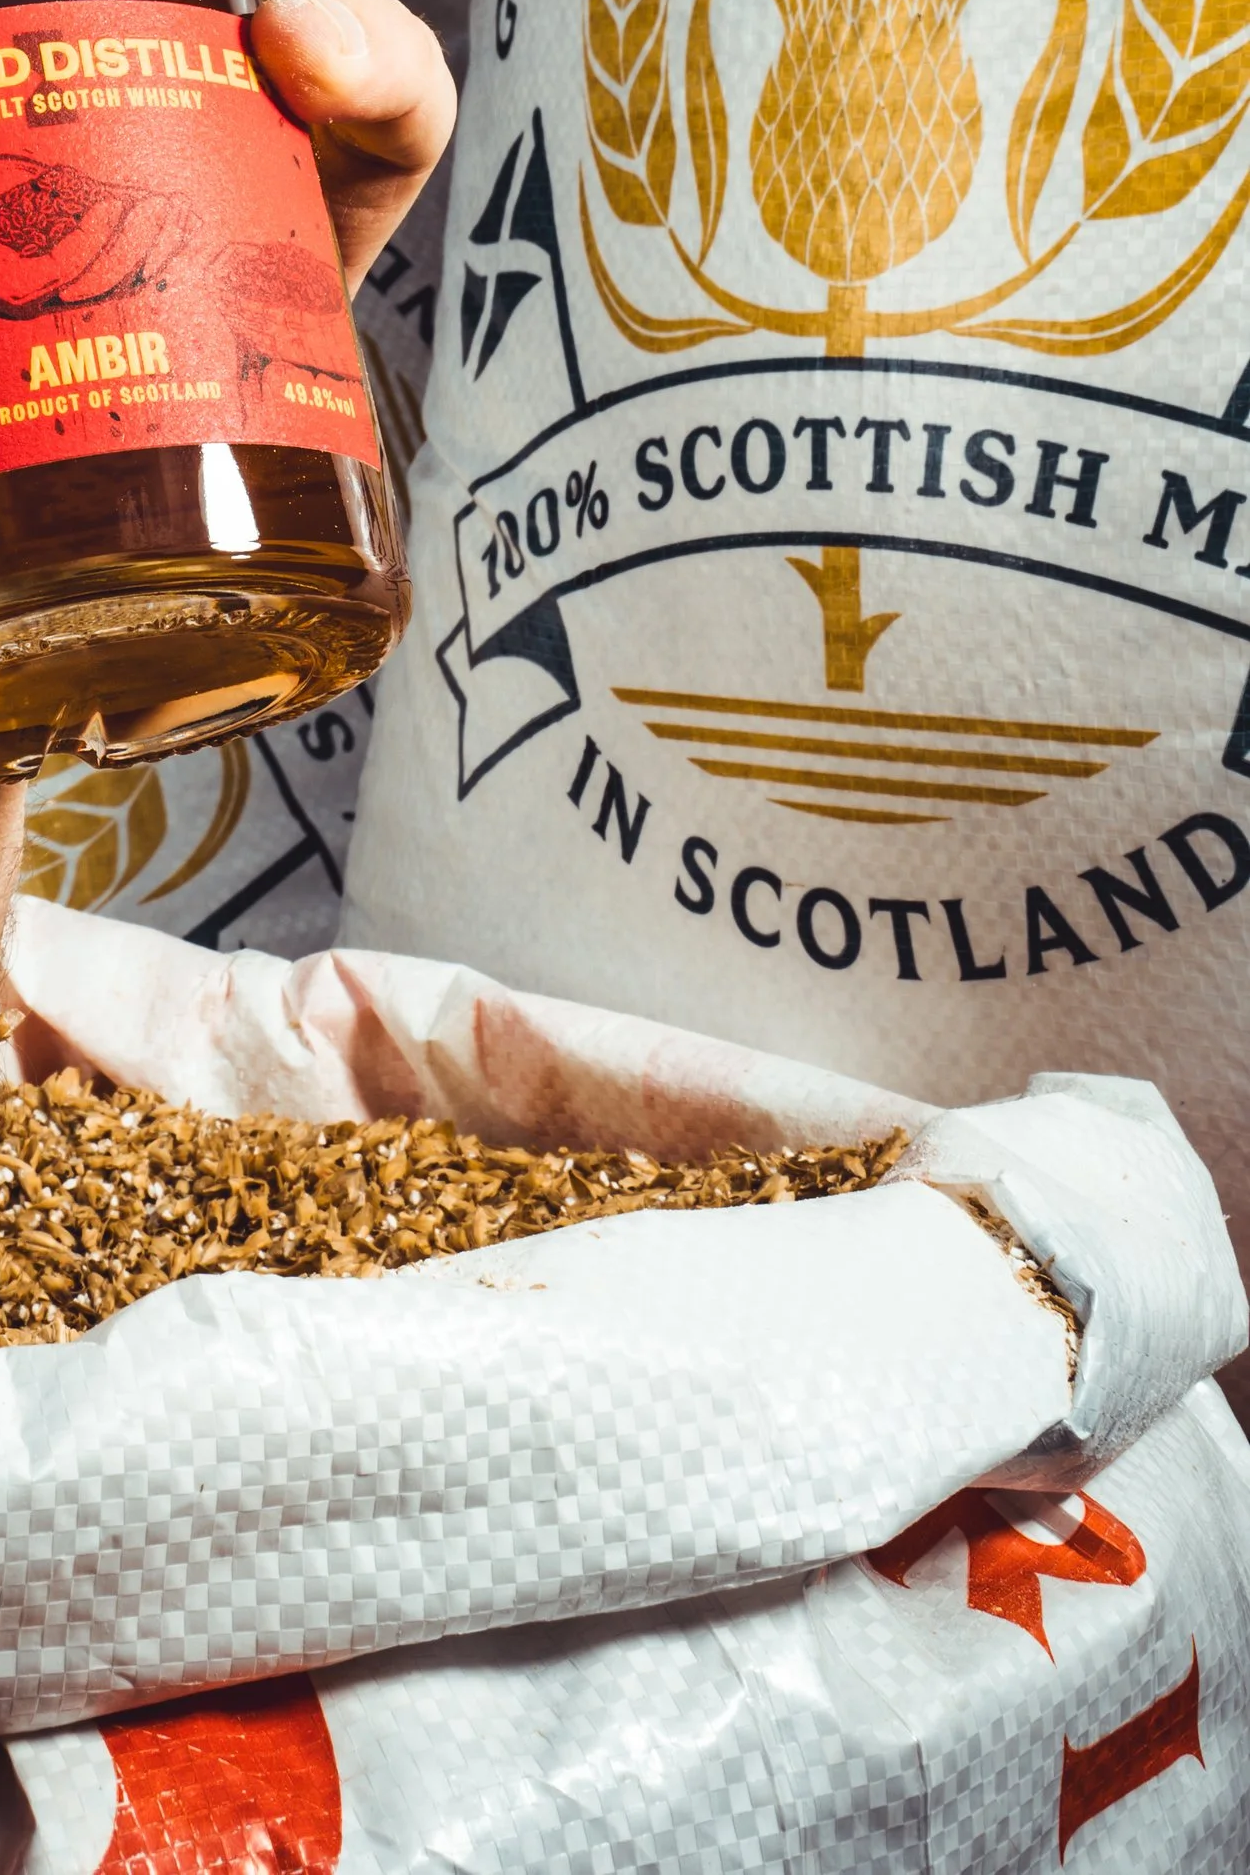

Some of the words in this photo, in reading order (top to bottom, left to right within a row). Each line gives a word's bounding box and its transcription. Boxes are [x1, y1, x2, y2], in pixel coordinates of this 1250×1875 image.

[38, 37, 260, 93] DISTILLE
[32, 87, 121, 115] SCOTCH
[125, 86, 203, 111] WHISKY
[29, 330, 171, 391] AMBIR
[88, 387, 114, 409] OF
[118, 381, 223, 406] SCOTLAND
[480, 459, 609, 601] 100%
[635, 415, 1110, 529] SCOTTISH
[565, 734, 653, 866] IN
[674, 811, 1250, 983] SCOTLAND
